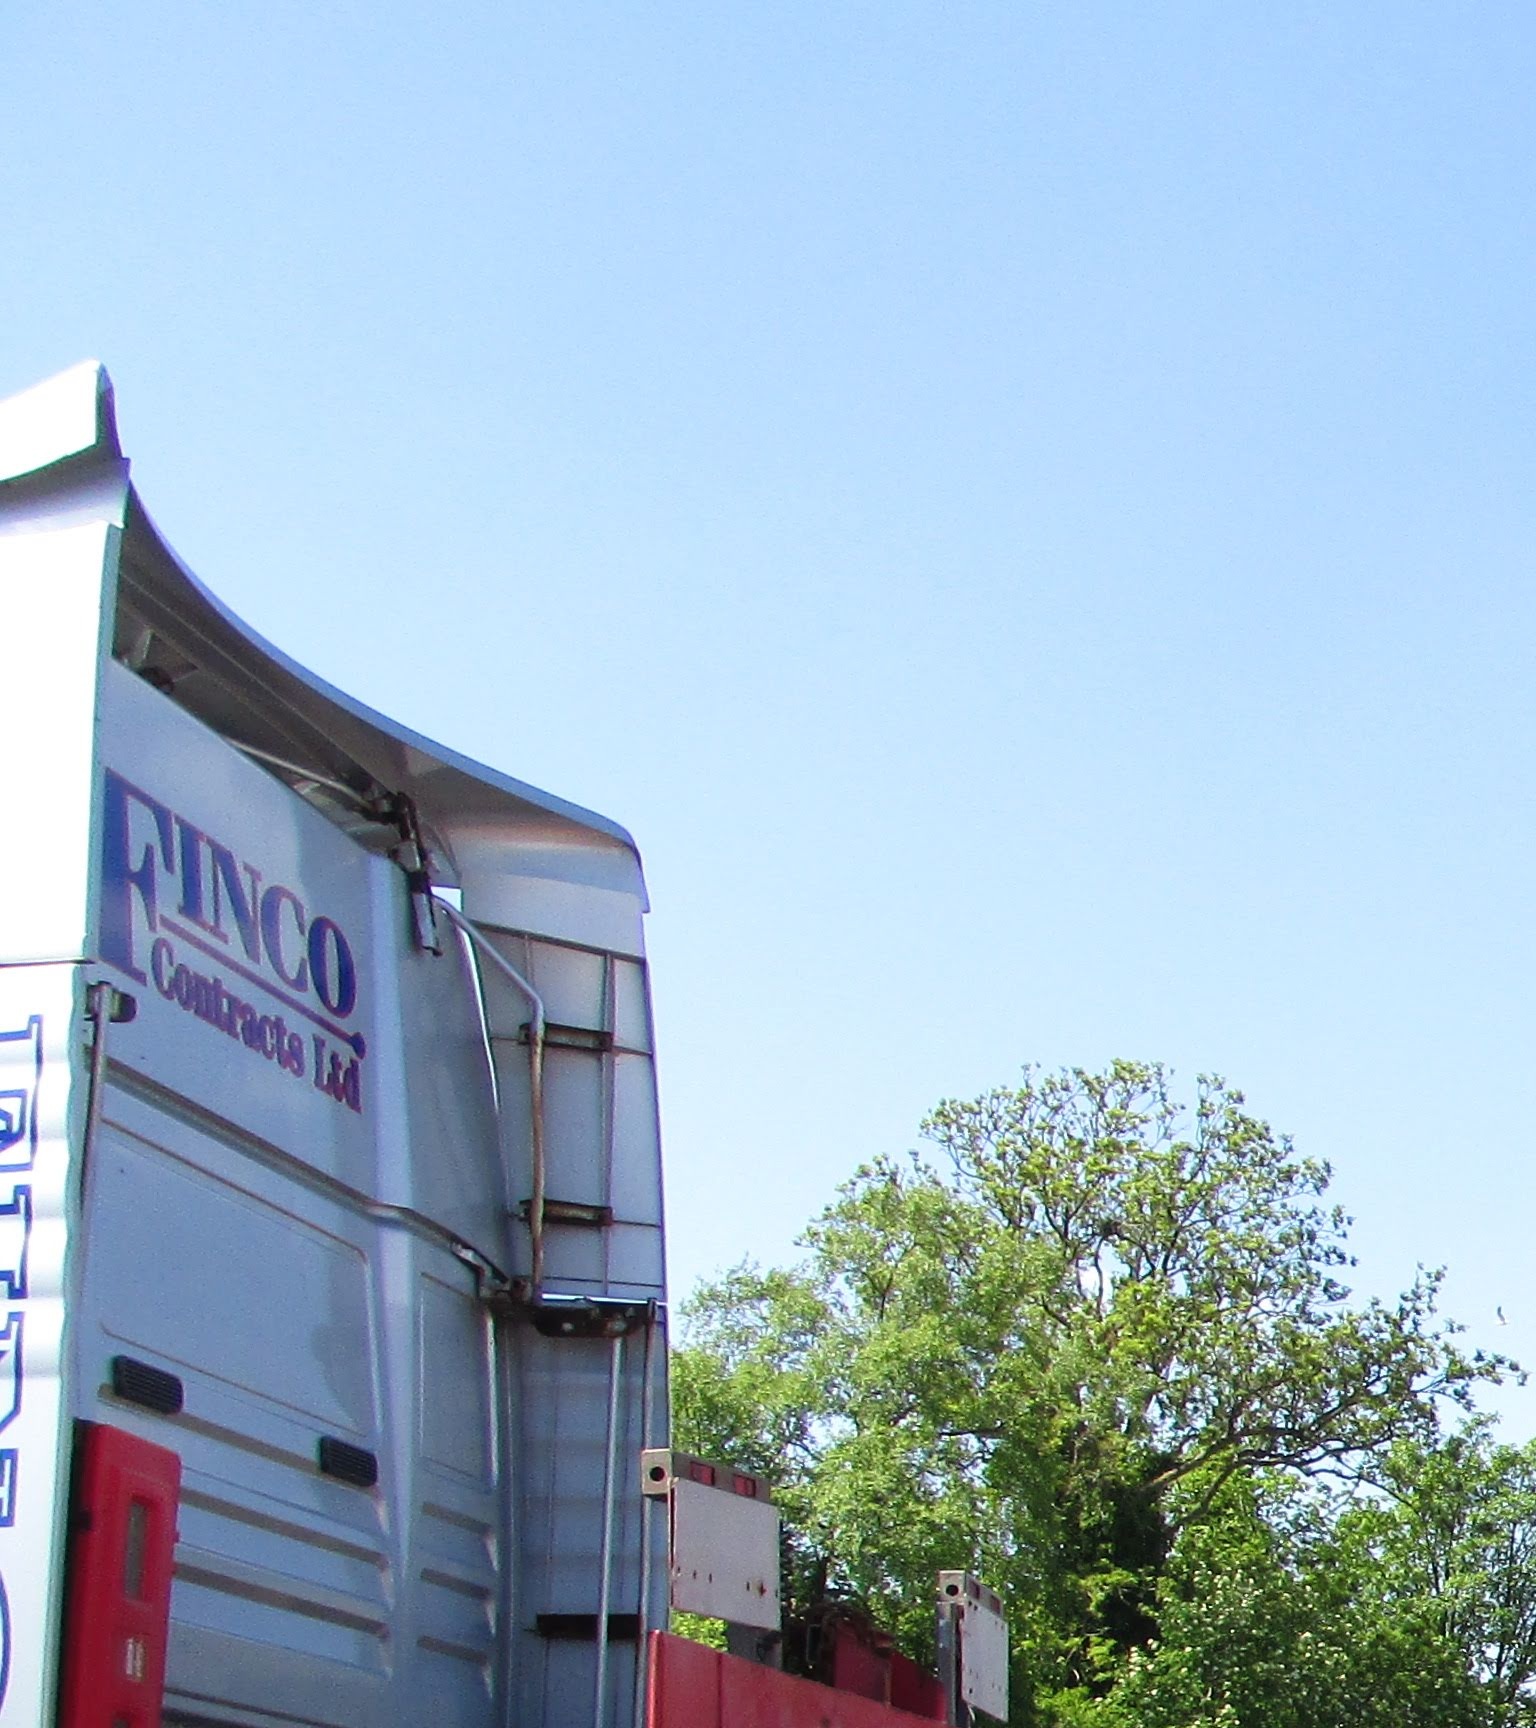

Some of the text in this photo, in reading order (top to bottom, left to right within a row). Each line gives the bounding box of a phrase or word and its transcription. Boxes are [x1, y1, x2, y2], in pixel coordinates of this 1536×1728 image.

[98, 766, 357, 1019] FINCO
[151, 937, 362, 1114] Contracts Ltd
